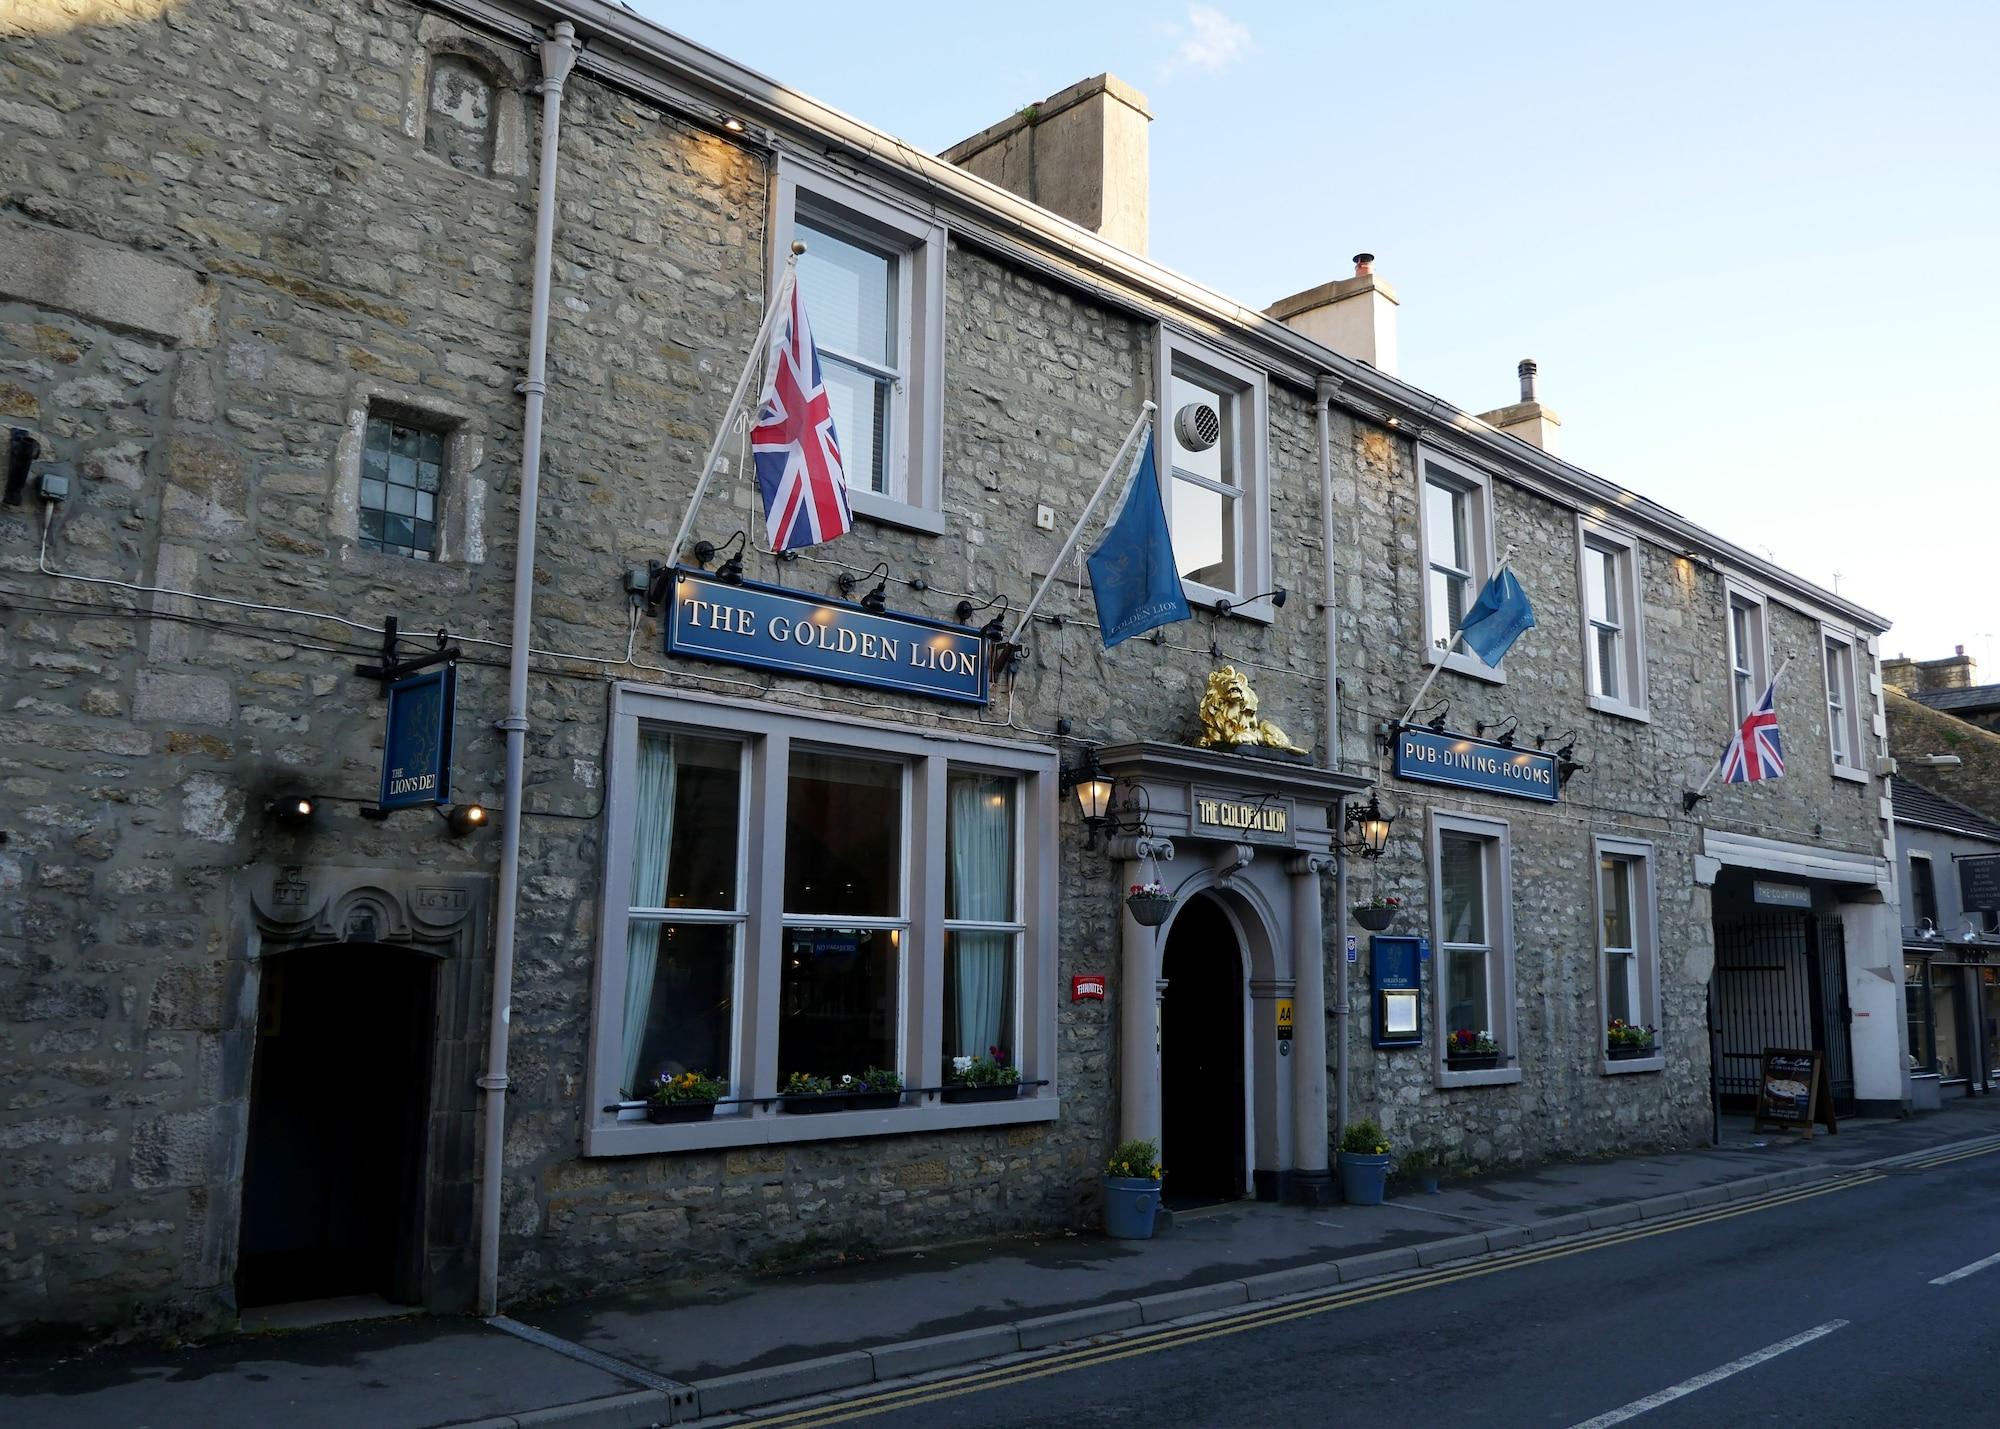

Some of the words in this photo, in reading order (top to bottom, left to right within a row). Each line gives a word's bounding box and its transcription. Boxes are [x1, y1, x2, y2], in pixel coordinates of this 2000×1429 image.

[683, 599, 756, 637] THE
[768, 616, 900, 662] GOLDEN
[910, 642, 977, 677] LION
[391, 767, 404, 779] THE
[390, 776, 418, 795] LION'S
[1199, 799, 1219, 824] THE
[1220, 802, 1261, 829] GOLDEN
[1263, 808, 1286, 833] LION
[1758, 887, 1771, 898] THE
[1280, 1007, 1291, 1021] AA
